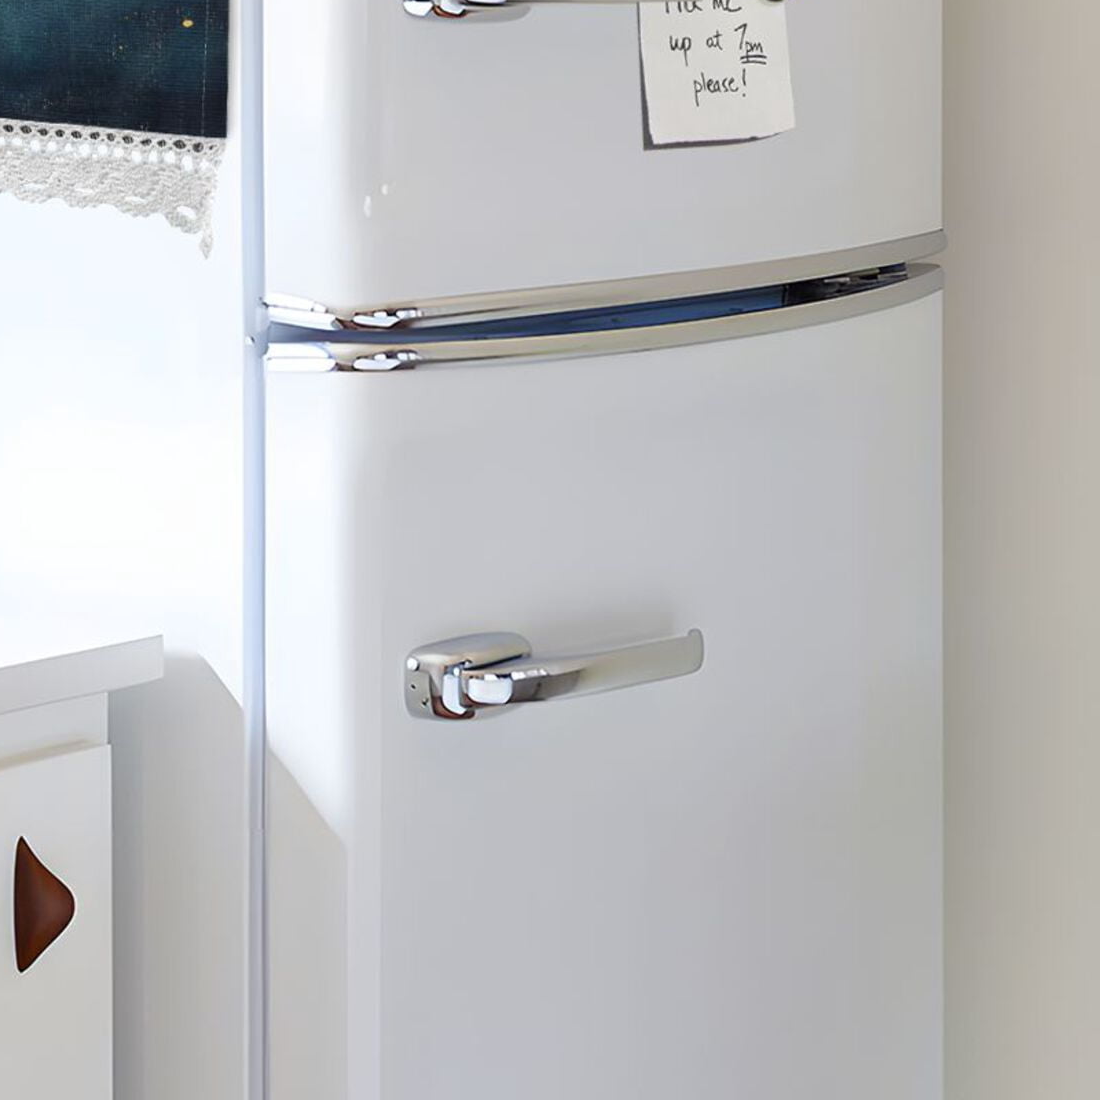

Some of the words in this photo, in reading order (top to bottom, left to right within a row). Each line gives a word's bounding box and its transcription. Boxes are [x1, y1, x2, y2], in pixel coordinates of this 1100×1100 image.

[669, 36, 692, 67] up
[706, 30, 723, 51] at
[693, 68, 747, 107] please!
